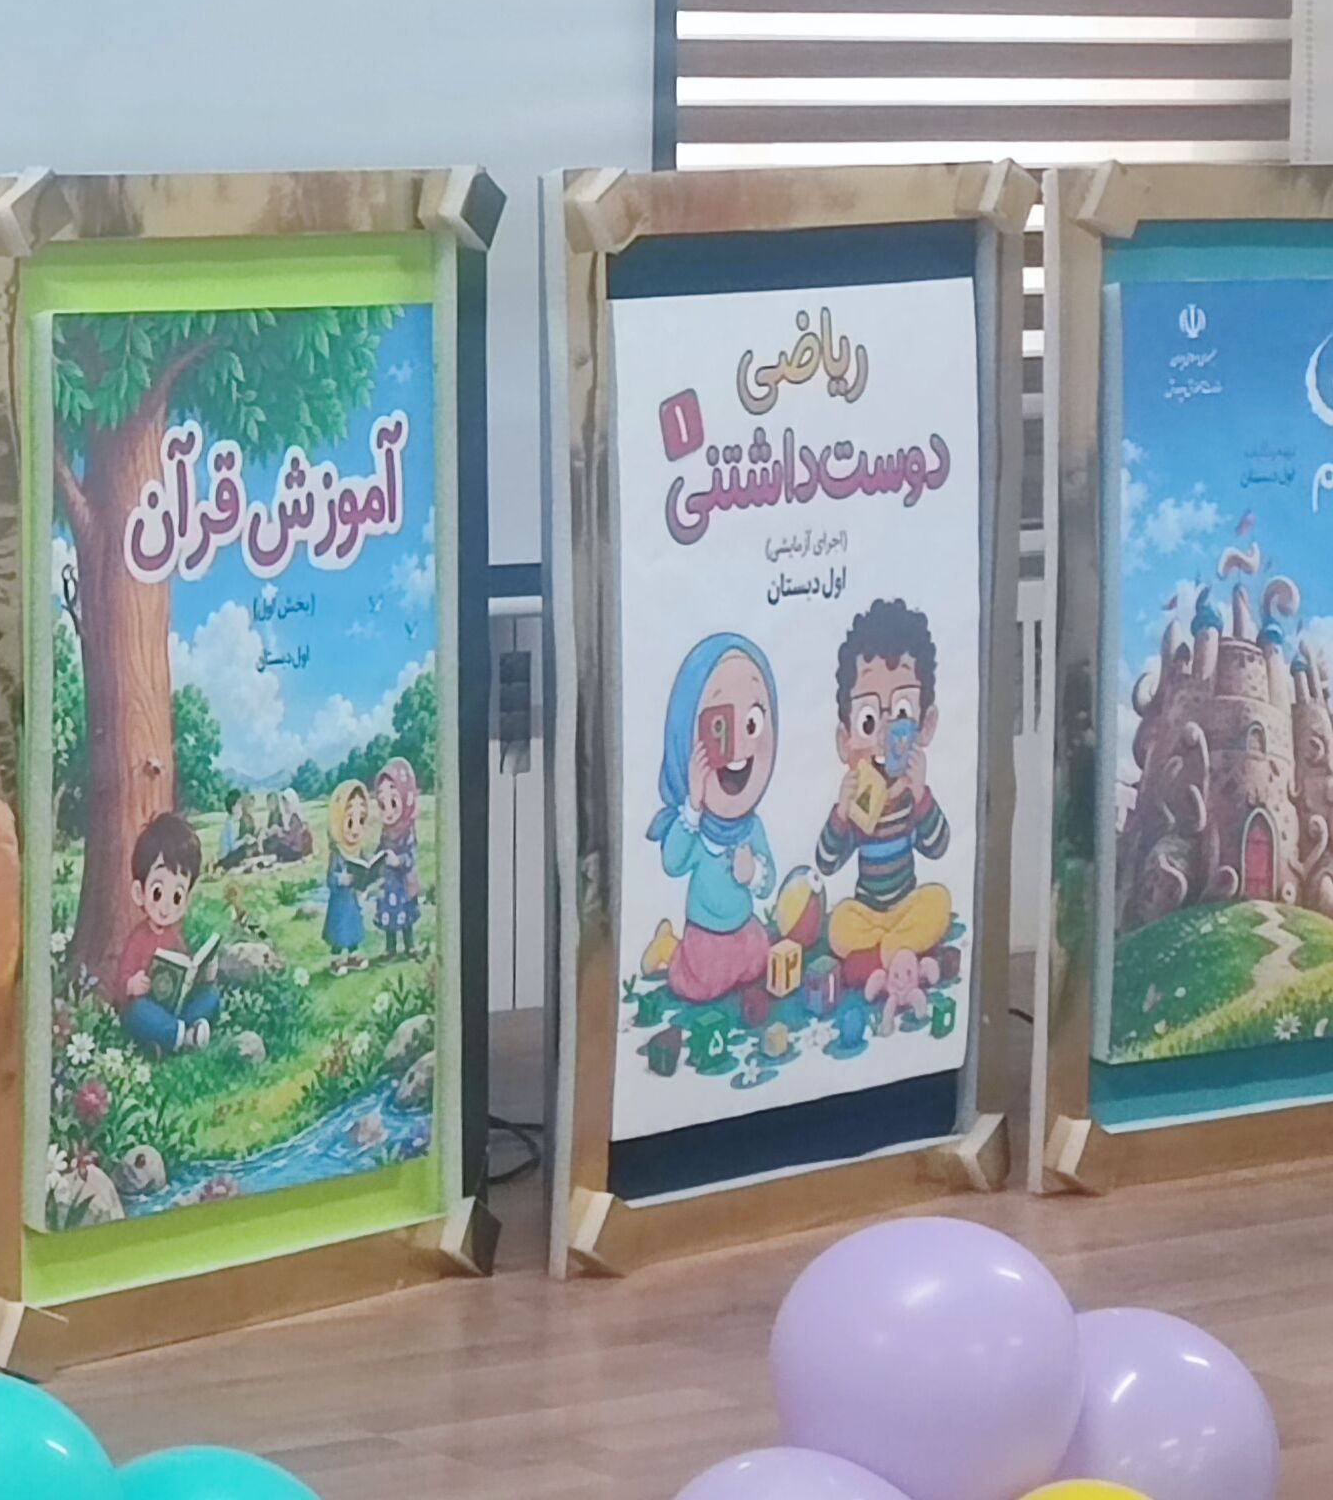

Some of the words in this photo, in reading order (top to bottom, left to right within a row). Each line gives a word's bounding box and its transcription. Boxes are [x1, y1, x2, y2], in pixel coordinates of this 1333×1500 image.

[736, 306, 869, 415] ریاضی
[132, 431, 241, 572] قرآن
[248, 420, 403, 567] آموزش
[767, 572, 820, 606] دبستان
[822, 565, 846, 599] اول
